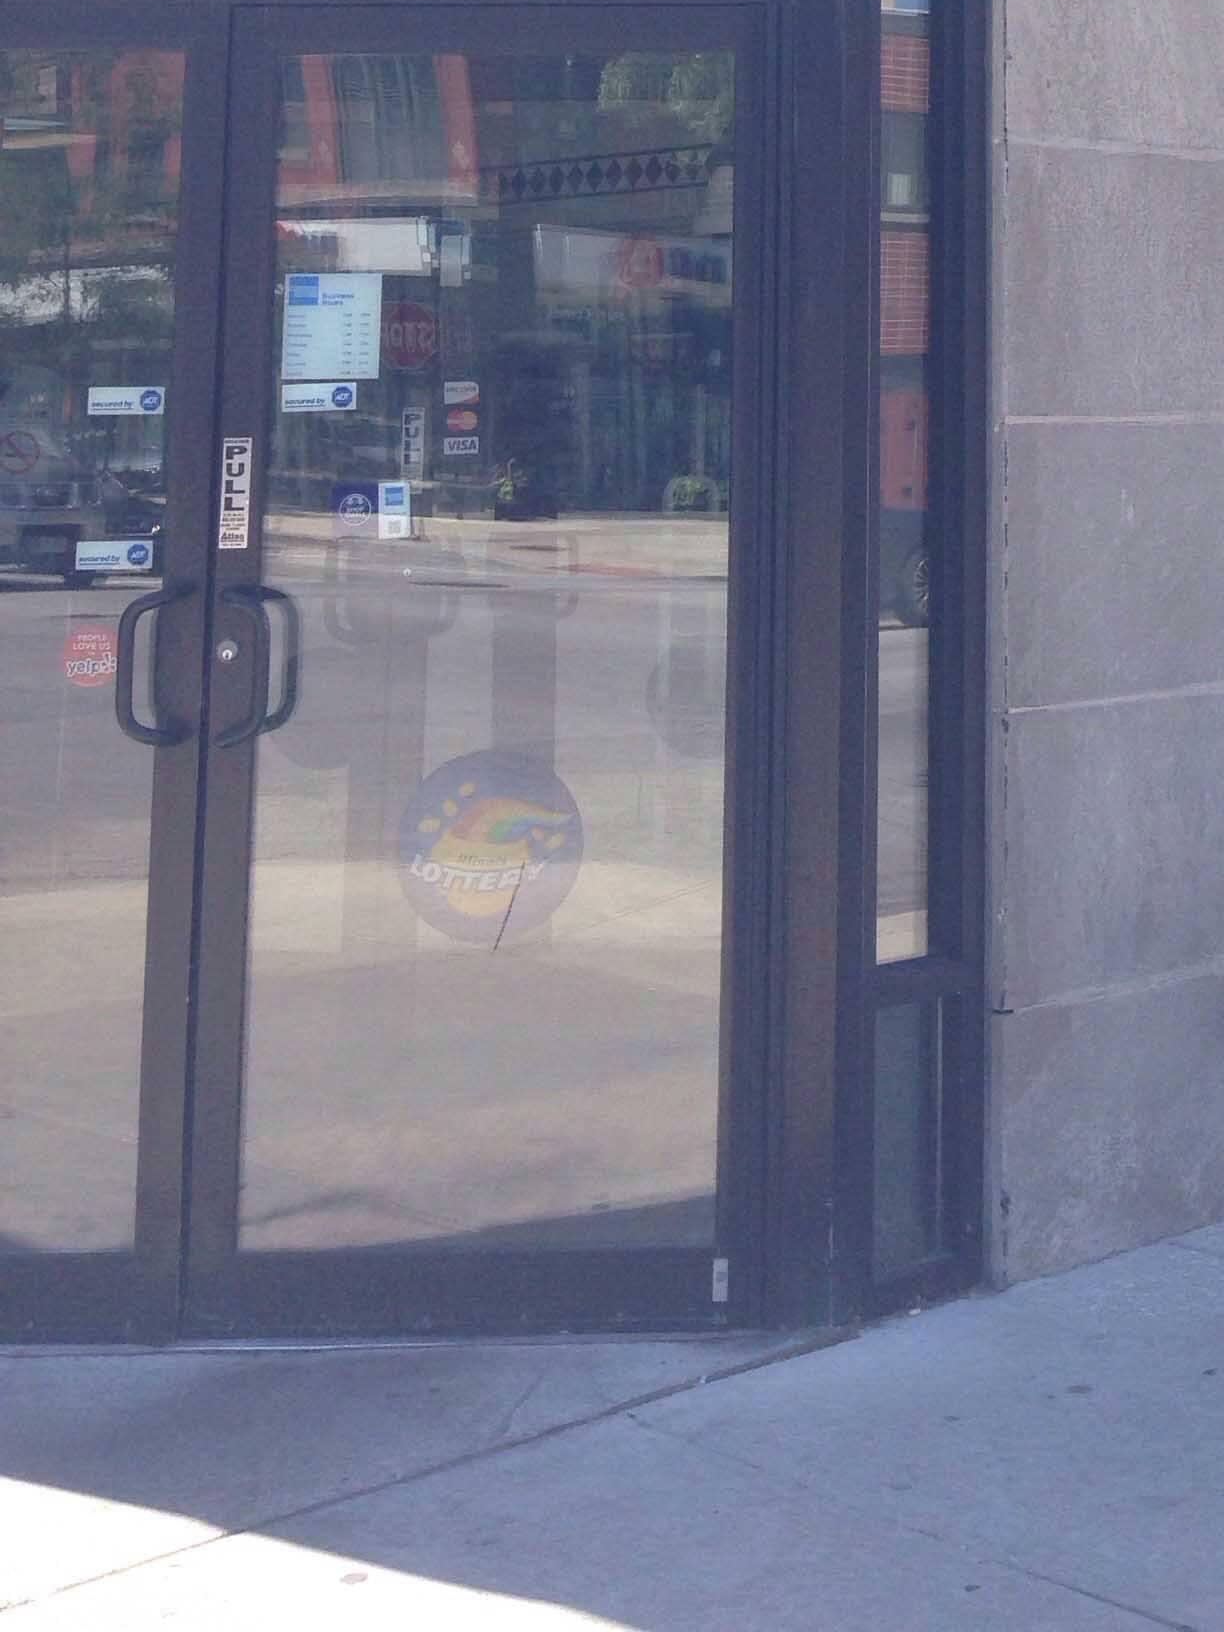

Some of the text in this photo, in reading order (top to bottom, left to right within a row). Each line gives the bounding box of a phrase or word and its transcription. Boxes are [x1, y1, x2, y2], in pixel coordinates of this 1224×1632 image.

[447, 439, 477, 451] VISA
[224, 446, 248, 511] PULL
[66, 658, 100, 677] yelp
